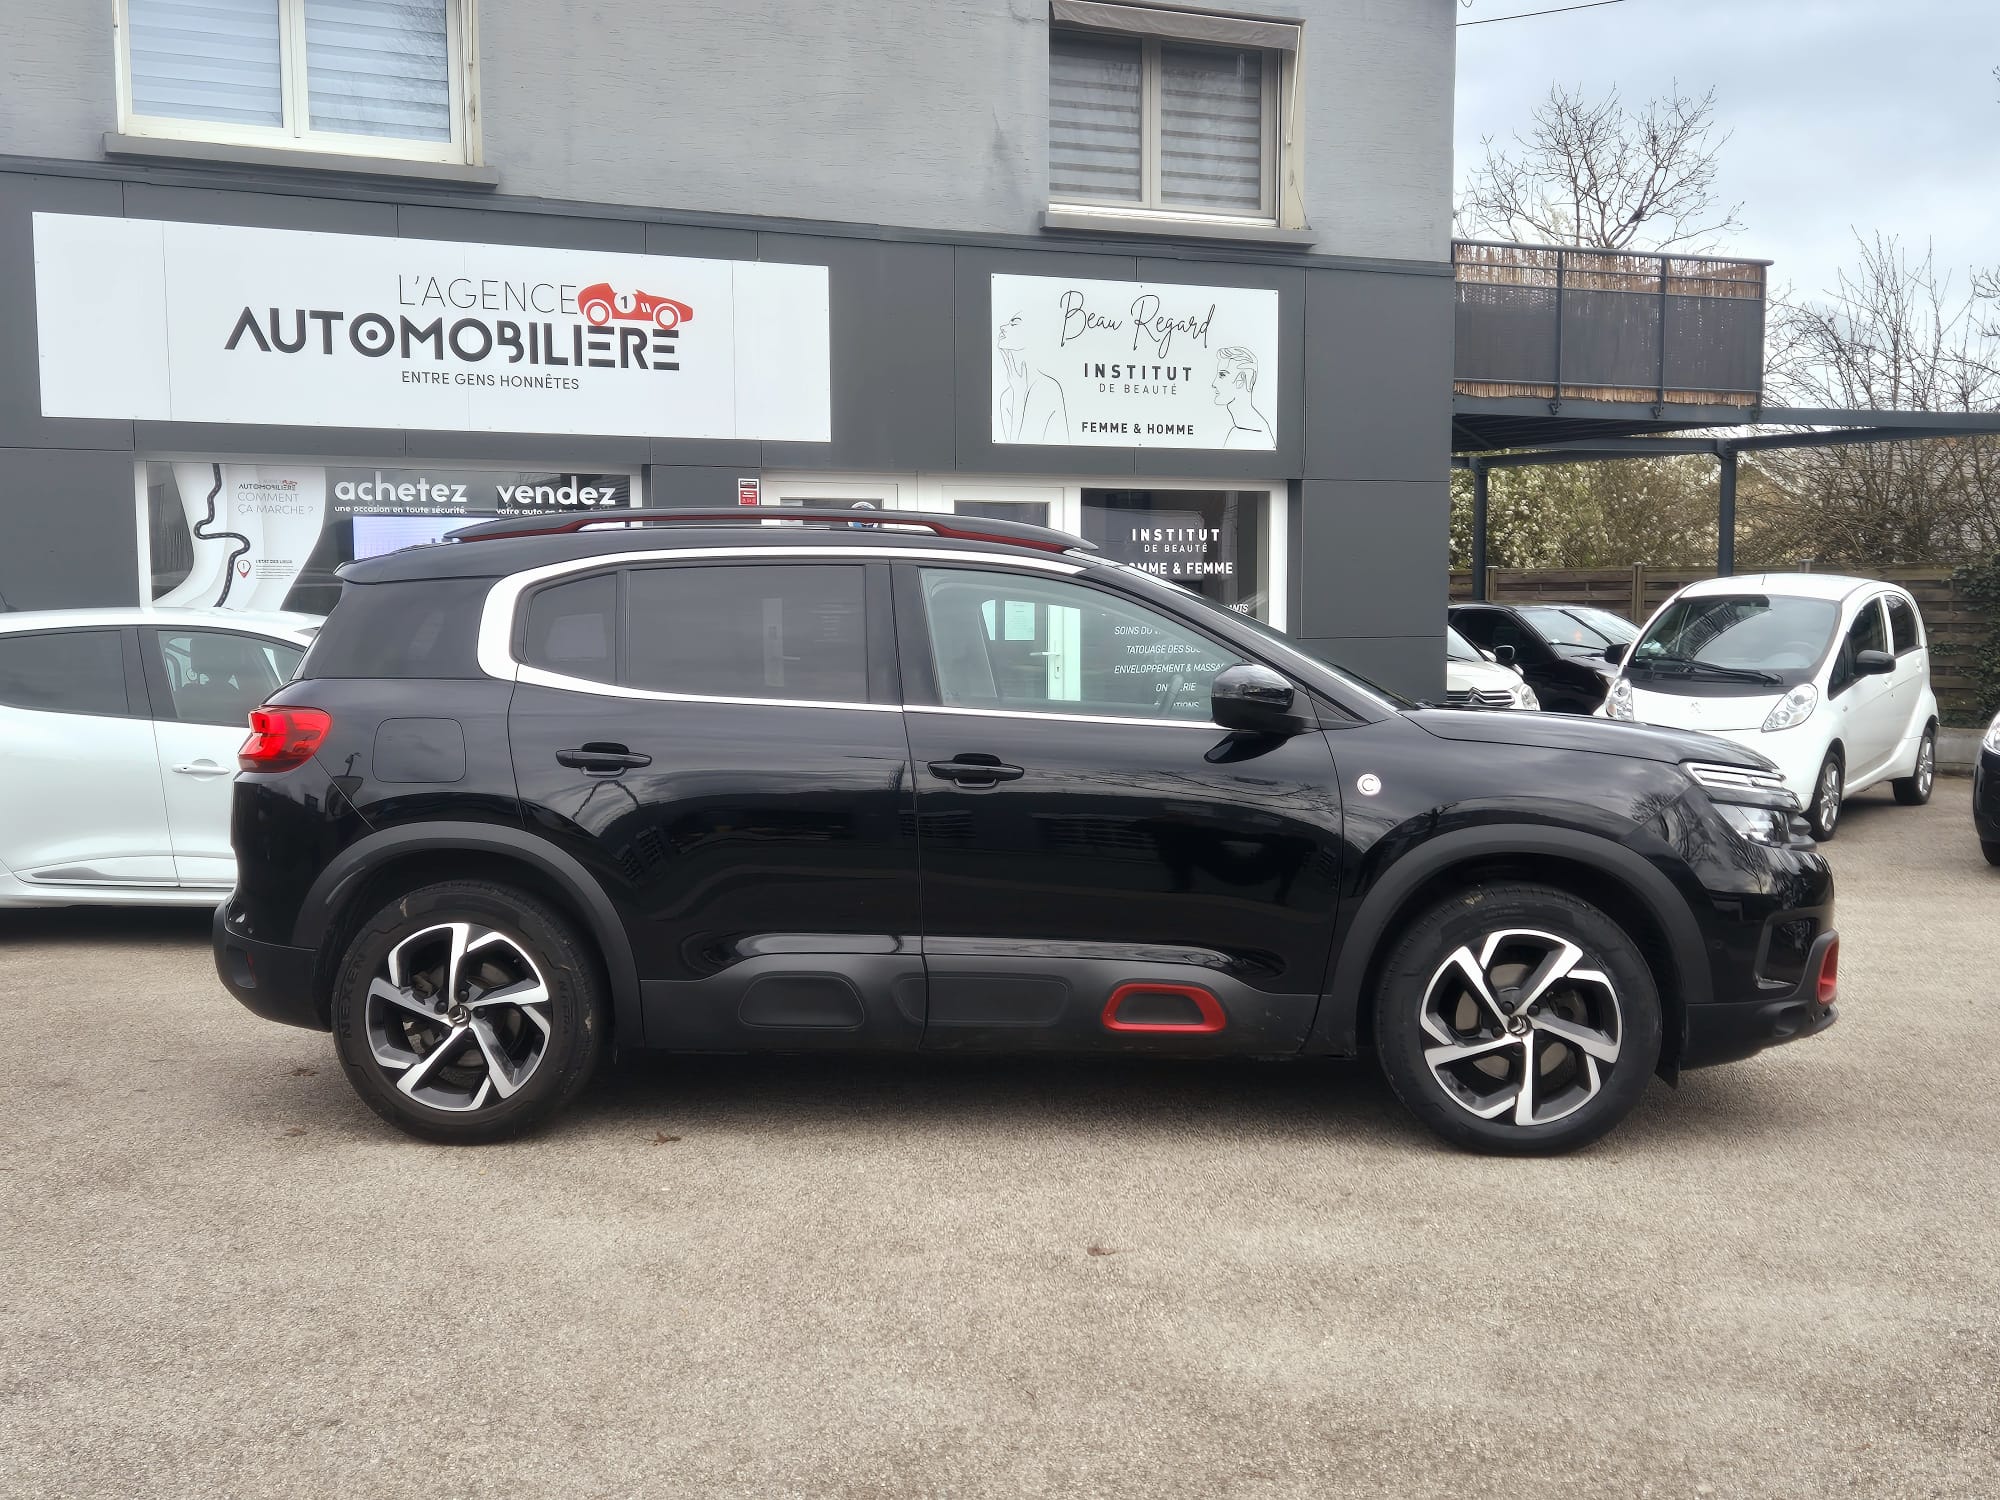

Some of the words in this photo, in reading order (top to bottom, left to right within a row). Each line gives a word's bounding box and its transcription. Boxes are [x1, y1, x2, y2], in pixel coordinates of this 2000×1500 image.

[398, 274, 578, 315] L'AGENCE
[620, 295, 628, 309] 1
[1060, 290, 1123, 347] Beau
[1130, 294, 1216, 359] Regard
[1083, 362, 1192, 382] INSTITUT
[401, 370, 450, 385] ENTRE
[454, 373, 495, 386] GENS
[500, 373, 580, 390] HONNÊTES
[1099, 383, 1115, 393] DE
[1124, 383, 1177, 395] BEAUTÉ
[1081, 421, 1128, 434] FEMME
[1133, 423, 1142, 434] &
[1147, 423, 1194, 435] HOMME
[334, 471, 468, 503] achetez
[496, 475, 616, 505] vendez
[237, 492, 300, 502] COMMENT
[256, 505, 305, 515] MARCHE
[353, 504, 390, 513] occasion
[406, 506, 429, 514] toute
[1132, 528, 1220, 542] INSTITUT
[1144, 544, 1158, 553] DE
[1164, 542, 1208, 553] BEAUTÉ
[1172, 562, 1181, 574] &
[1186, 562, 1233, 574] FEMME
[1114, 626, 1139, 635] SOINS
[1126, 644, 1167, 654] TATOUAGE
[1167, 644, 1184, 653] DES
[1114, 663, 1186, 674] ENVELOPPEMENT
[1186, 664, 1191, 672] &
